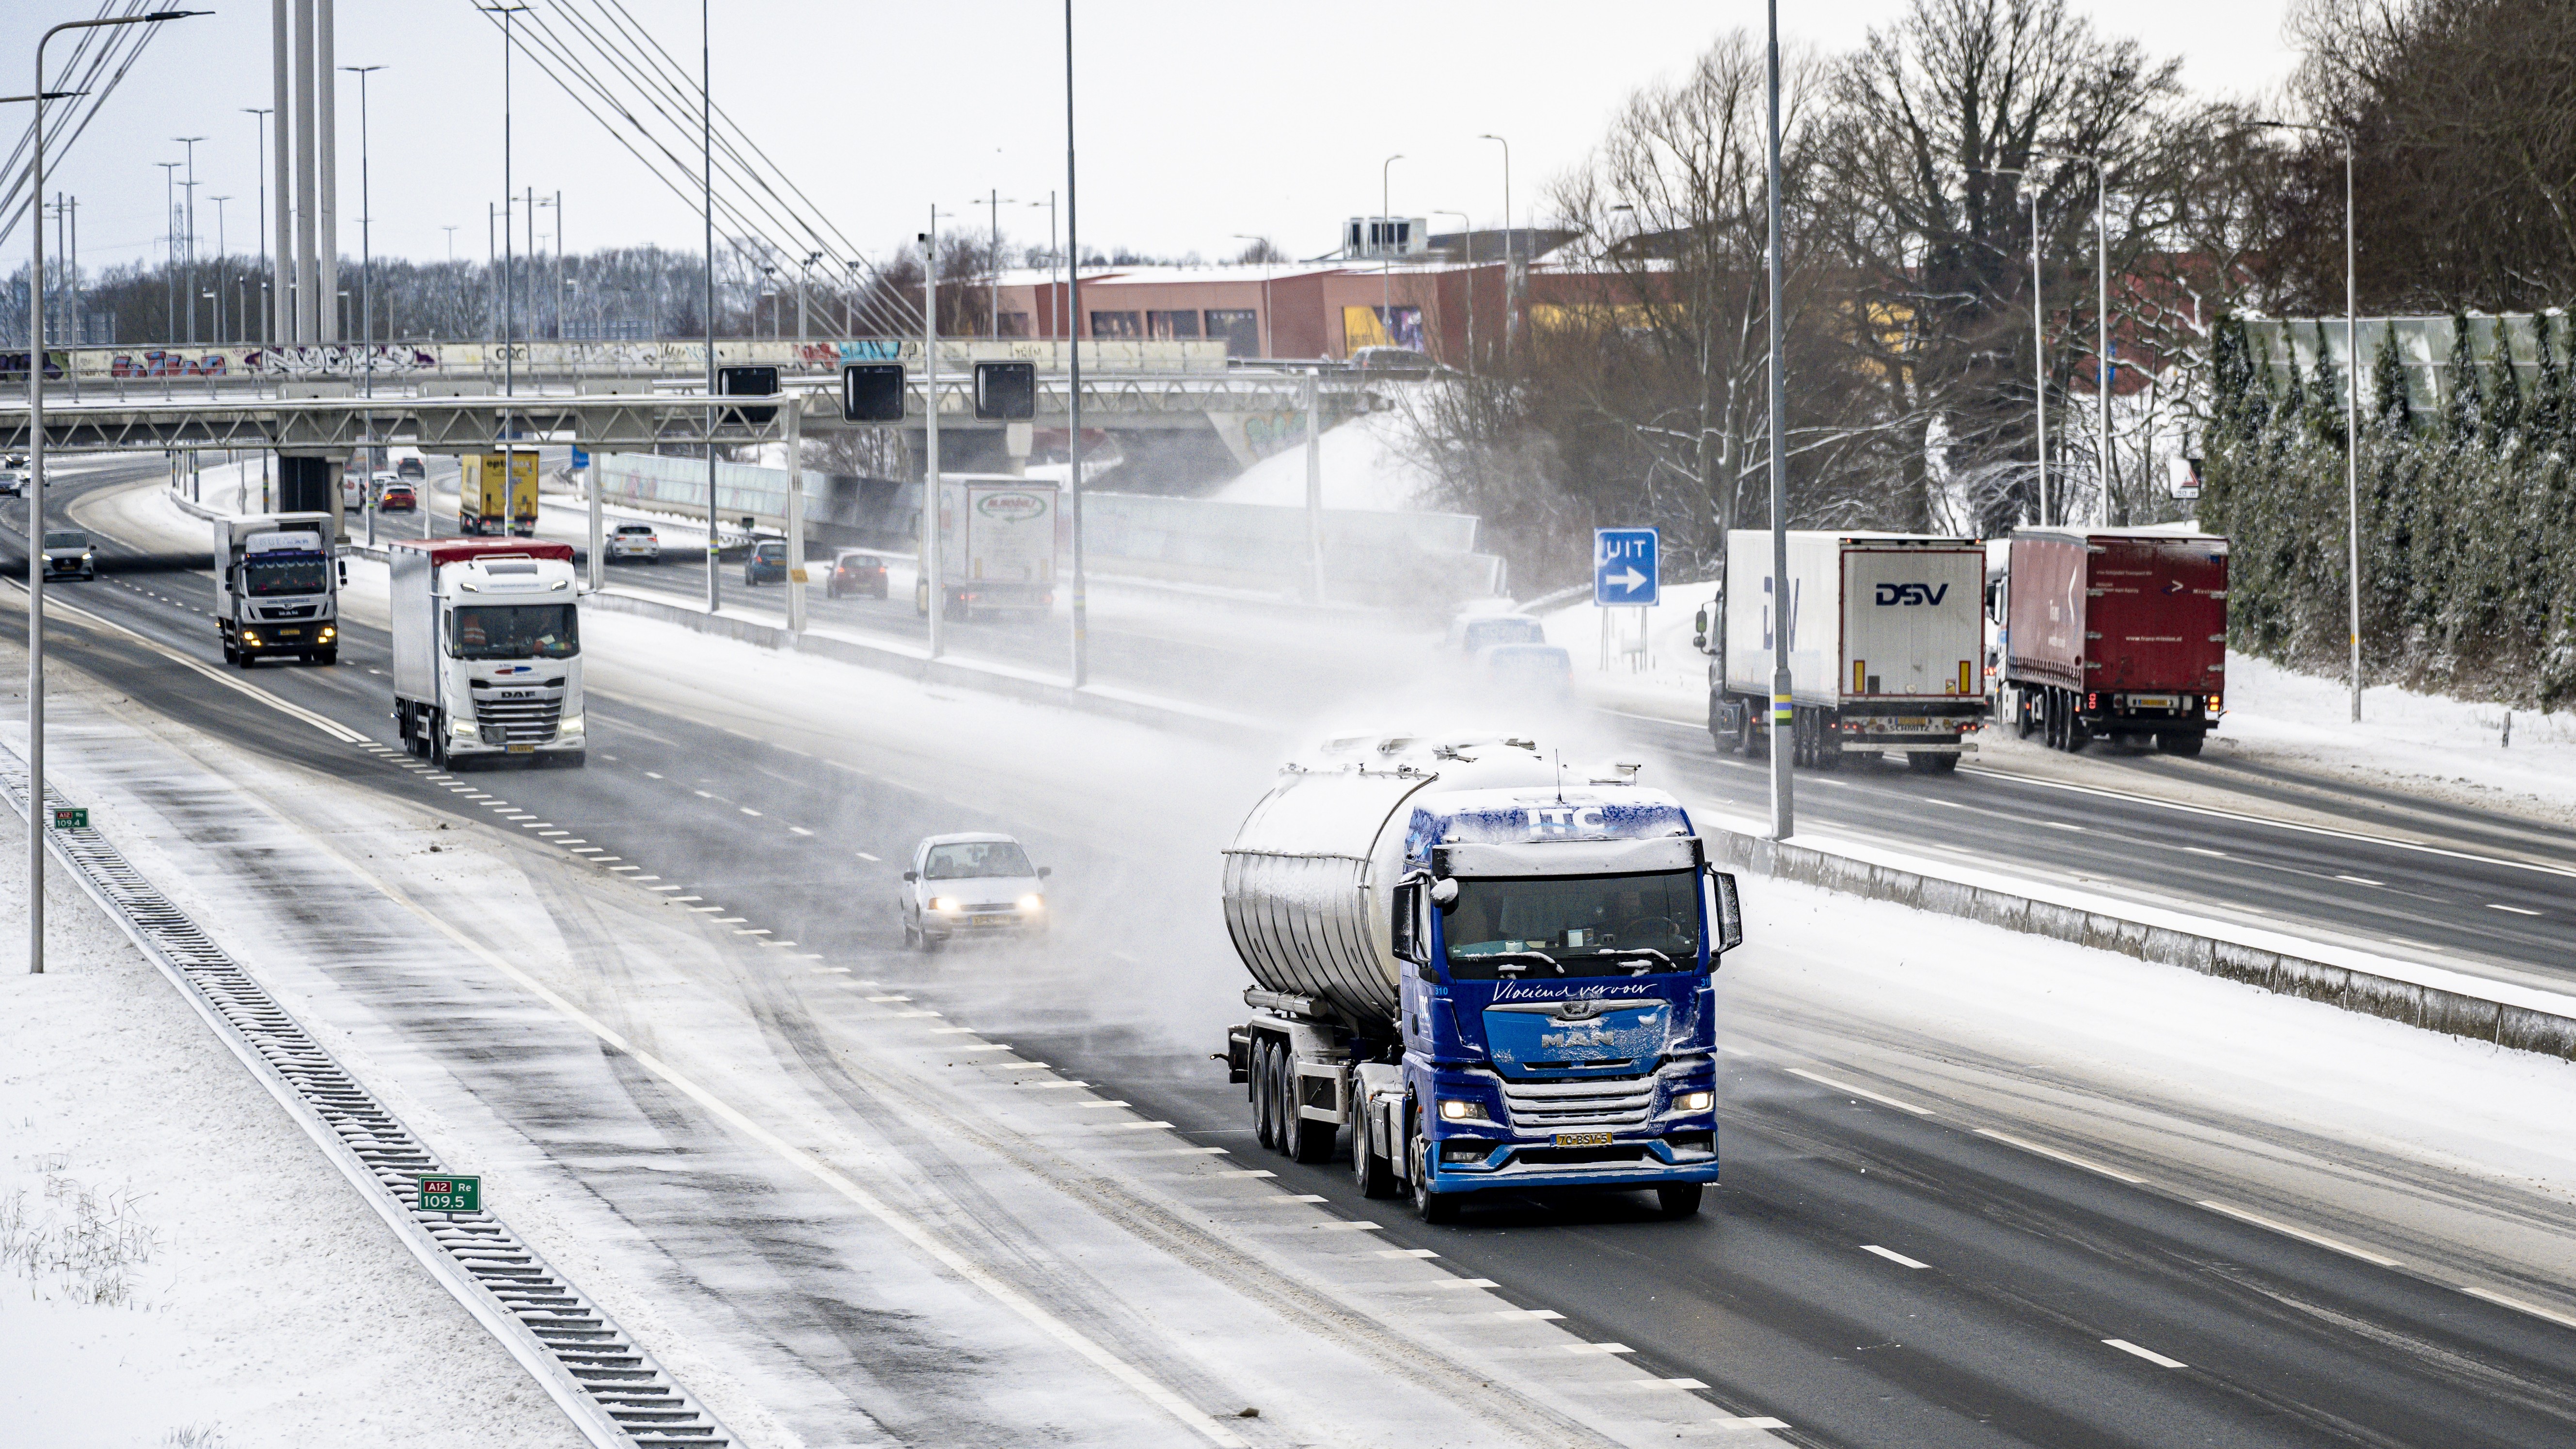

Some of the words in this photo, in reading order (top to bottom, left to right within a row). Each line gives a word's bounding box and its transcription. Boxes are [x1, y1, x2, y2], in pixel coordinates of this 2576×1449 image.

[1607, 540, 1646, 558] UIT
[1876, 583, 1948, 606] DSV
[1527, 807, 1606, 835] ITC
[1435, 987, 1448, 995] 310
[1419, 995, 1430, 1019] ITC
[1541, 1031, 1614, 1048] MAN
[1559, 1134, 1608, 1145] 70-BSV-5
[428, 1182, 447, 1191] A12
[458, 1183, 472, 1192] Re
